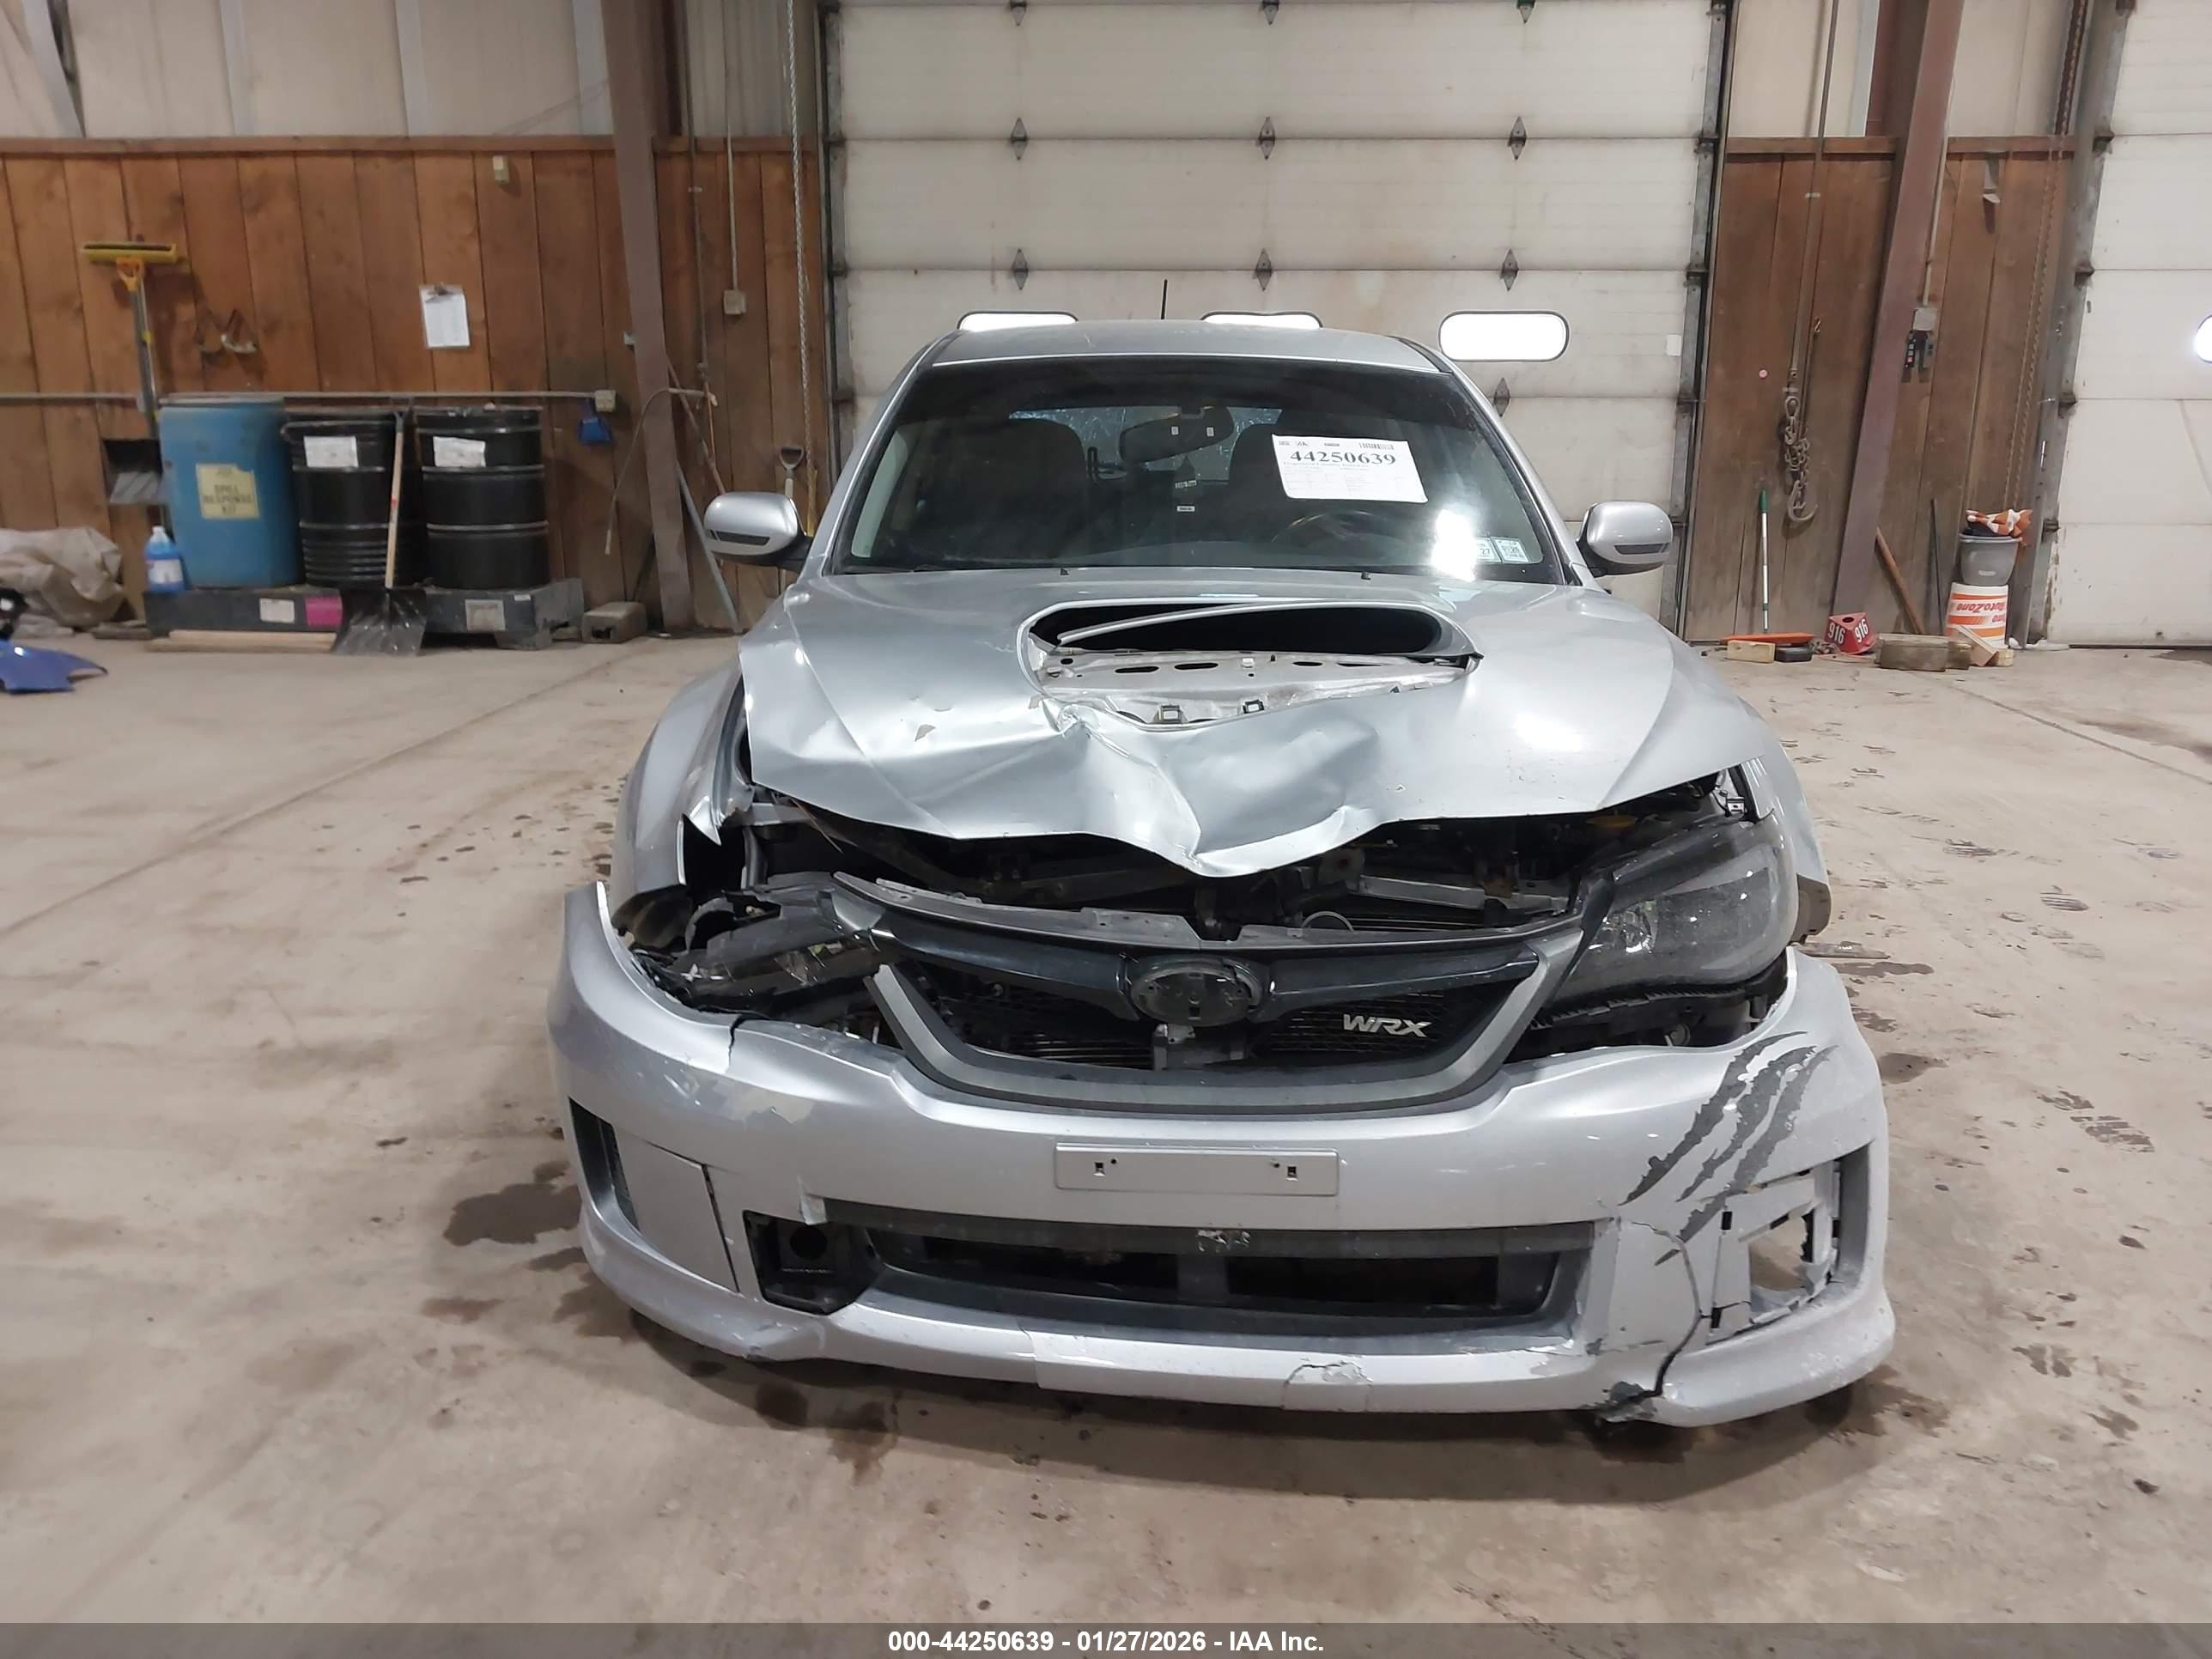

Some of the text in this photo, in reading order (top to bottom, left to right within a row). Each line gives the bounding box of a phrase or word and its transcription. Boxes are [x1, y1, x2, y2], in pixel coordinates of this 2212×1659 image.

[1290, 451, 1396, 465] 44250639
[1827, 622, 1845, 644] 916
[1855, 618, 1869, 642] 916
[1343, 1013, 1432, 1038] WRX
